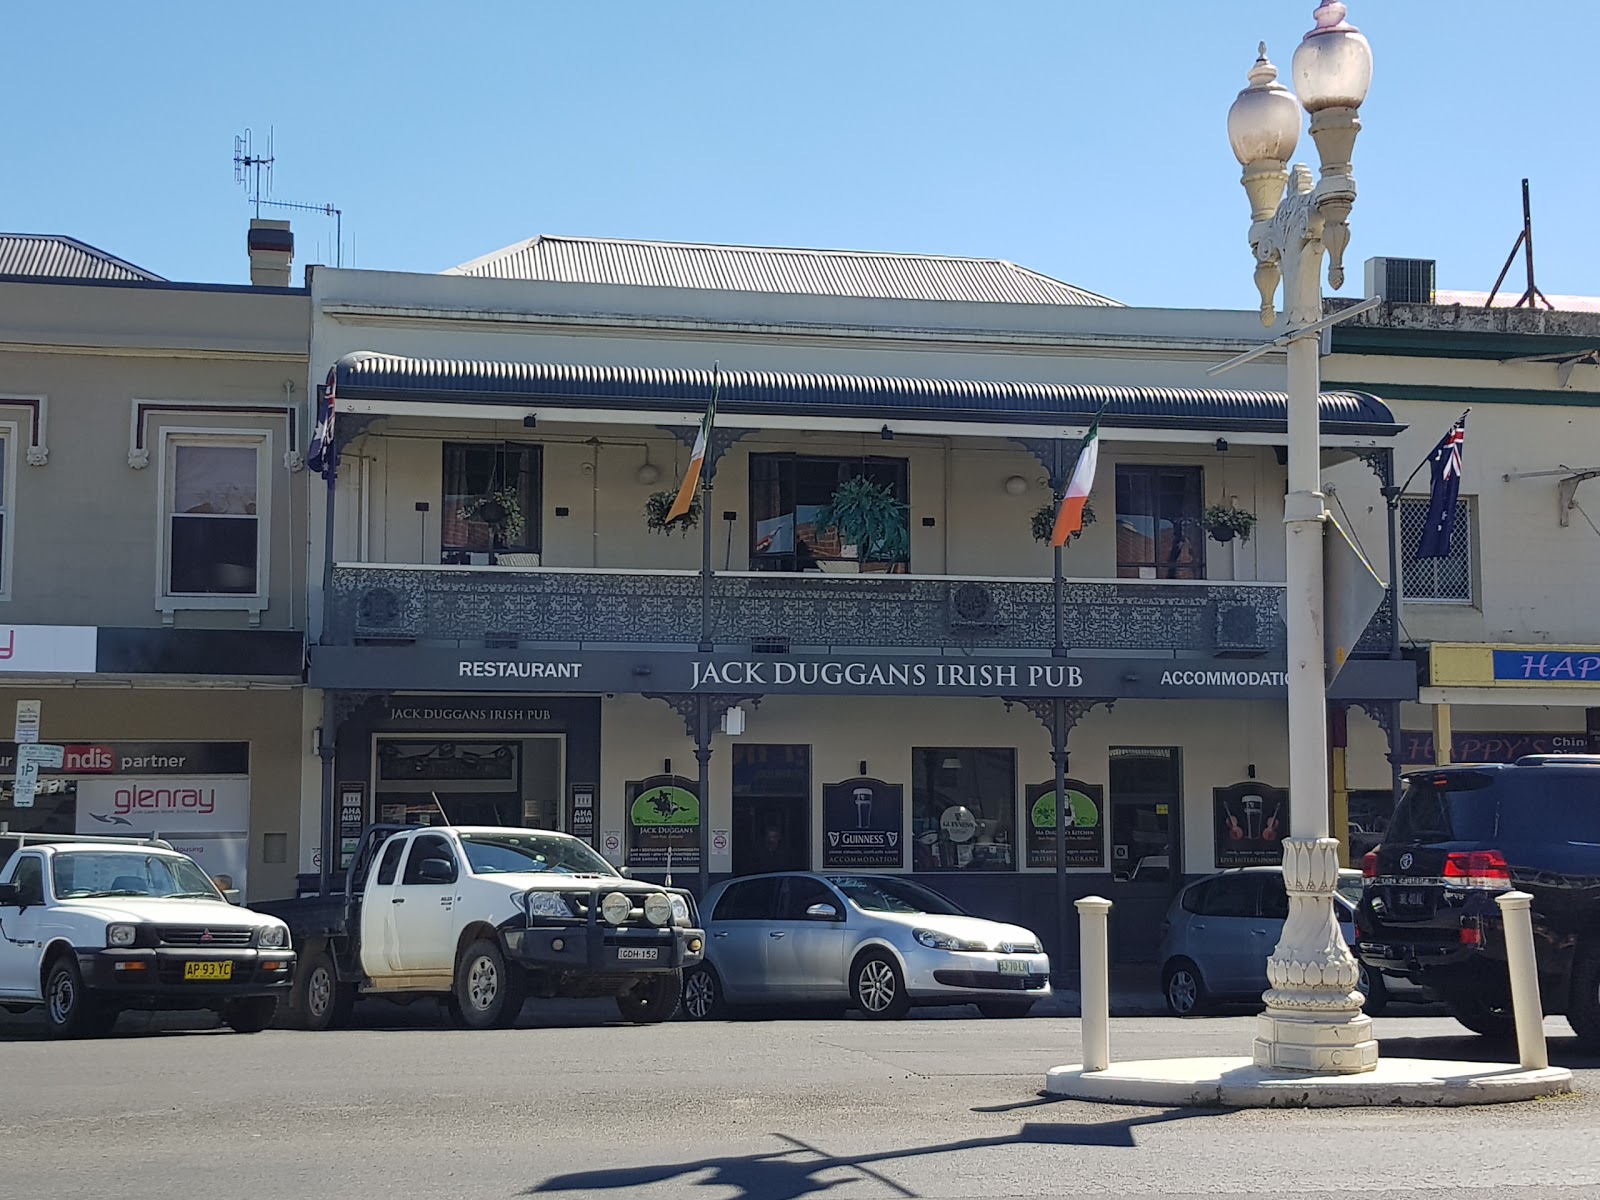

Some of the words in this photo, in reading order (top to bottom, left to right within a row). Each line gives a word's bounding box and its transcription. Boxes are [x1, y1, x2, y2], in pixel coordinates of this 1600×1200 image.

[459, 661, 582, 678] RESTAURANT
[690, 661, 767, 690] JACK
[773, 662, 926, 686] DUGGANS
[936, 664, 1018, 687] IRISH
[1028, 665, 1083, 687] PUB
[391, 708, 421, 720] JACK
[424, 709, 486, 720] DUGGANS
[489, 709, 523, 720] IRISH
[527, 709, 551, 720] PUB
[1408, 737, 1546, 760] HPPY'S
[67, 748, 112, 769] ndis
[121, 754, 186, 770] partner
[114, 784, 215, 815] glenray
[342, 807, 361, 815] AHA
[341, 814, 362, 822] NSW
[573, 816, 593, 824] NSW
[639, 826, 657, 834] JACK
[658, 826, 693, 834] DUGGANS
[842, 833, 884, 844] GUINNESS
